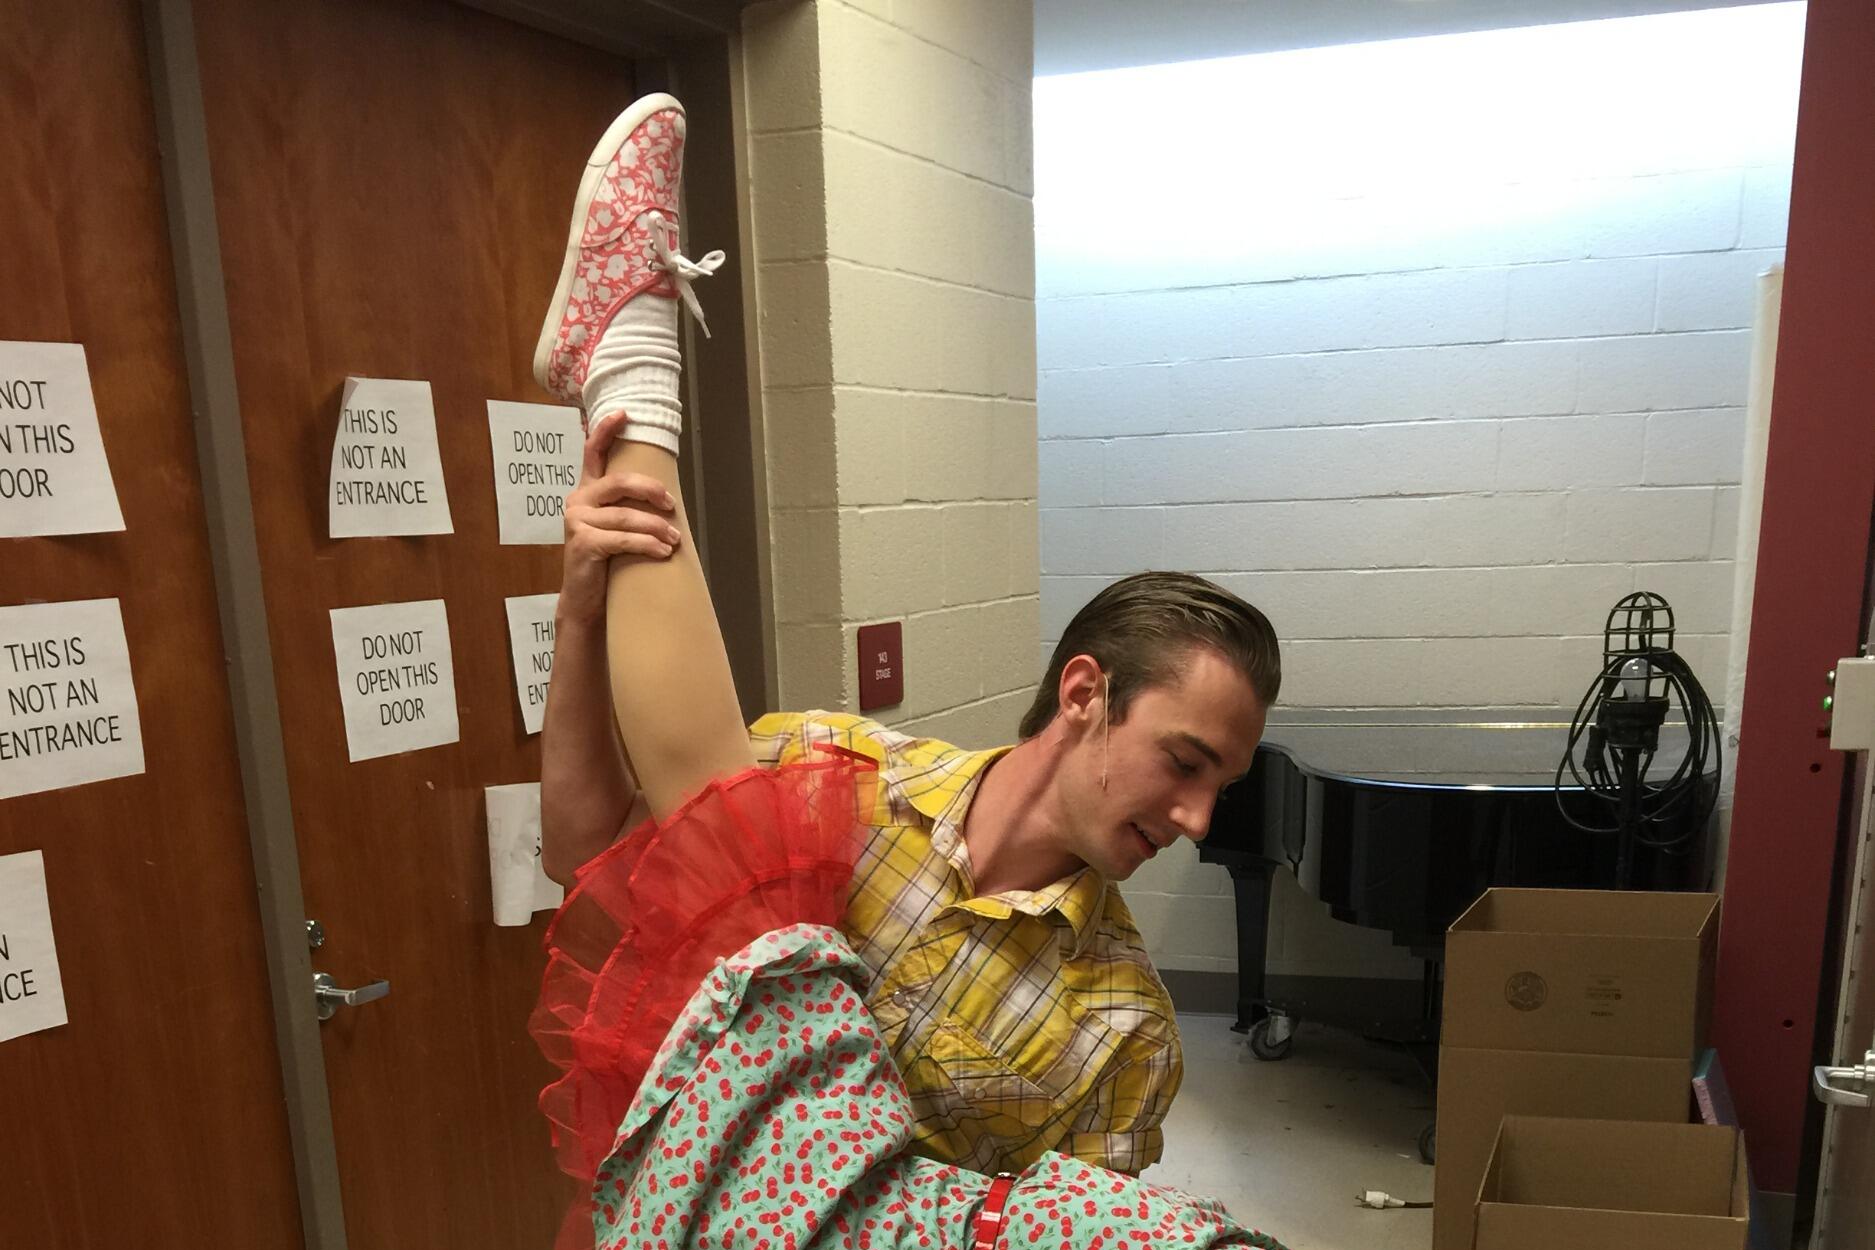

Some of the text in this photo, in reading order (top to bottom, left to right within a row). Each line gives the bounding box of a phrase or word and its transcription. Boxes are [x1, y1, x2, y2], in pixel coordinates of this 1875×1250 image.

[0, 380, 46, 410] NOT
[344, 409, 398, 434] THIS IS
[15, 424, 75, 454] THIS
[513, 430, 564, 454] DO NOT
[341, 445, 406, 469] NOT AN
[0, 468, 53, 498] OOR
[508, 462, 575, 486] OPEN THIS
[336, 480, 428, 505] ENTRANCE
[526, 495, 565, 517] DOOR
[362, 630, 423, 660] DO NOT
[531, 620, 554, 642] THI
[3, 636, 85, 672] THIS IS
[532, 651, 555, 673] NO
[356, 662, 438, 695] OPEN THIS
[8, 677, 99, 716] NOT AN
[379, 697, 425, 726] DOOR
[0, 715, 122, 760] ENTRANCE
